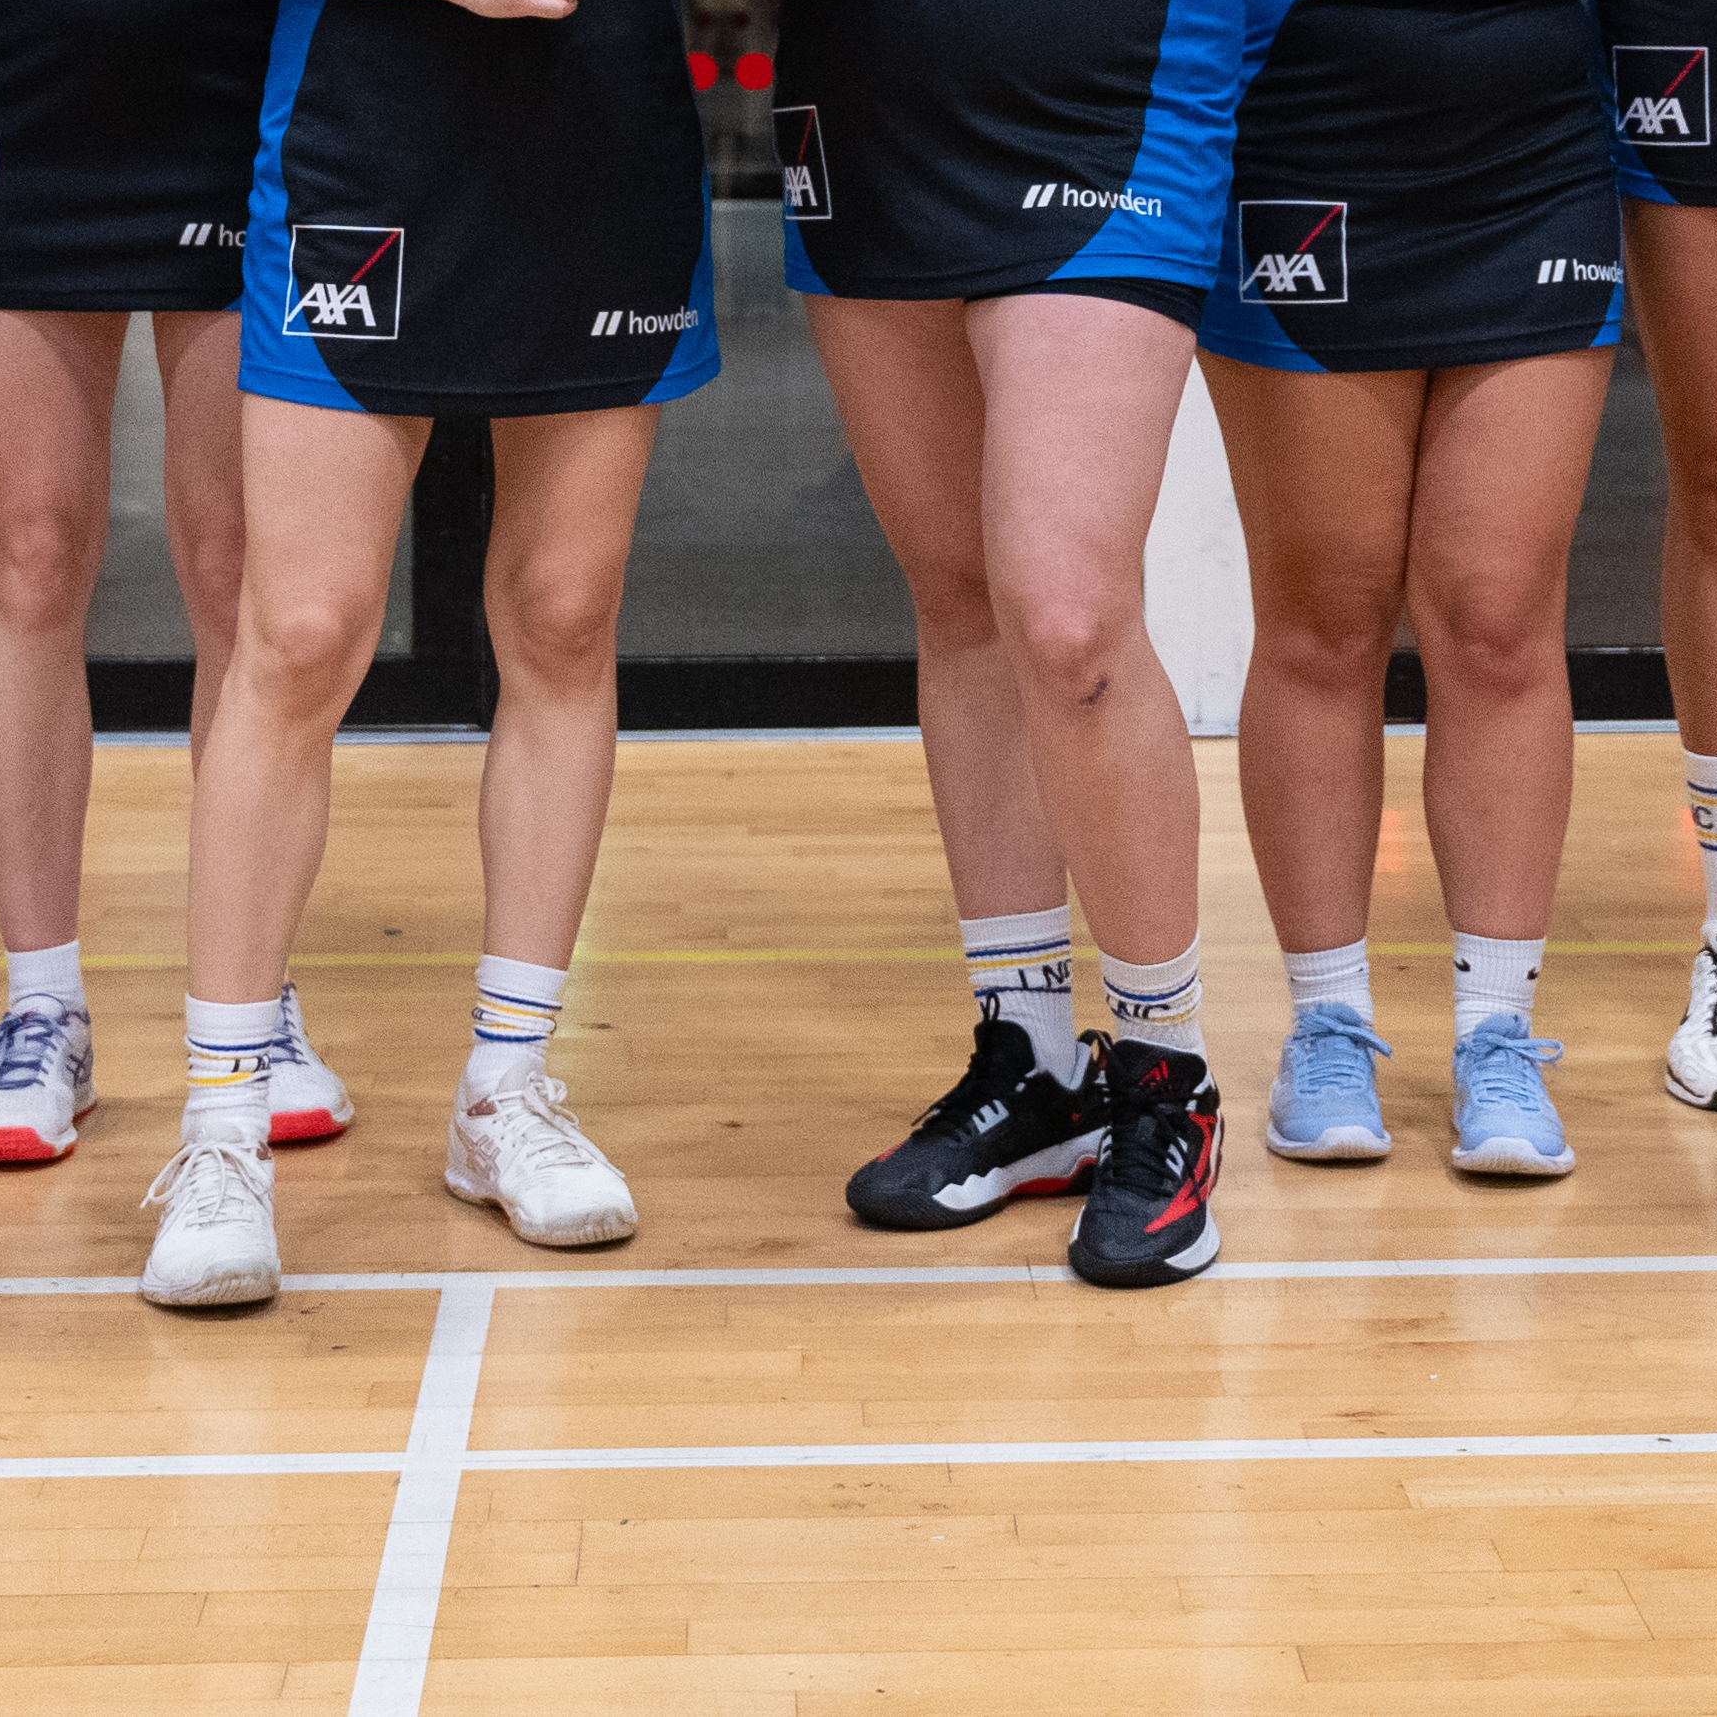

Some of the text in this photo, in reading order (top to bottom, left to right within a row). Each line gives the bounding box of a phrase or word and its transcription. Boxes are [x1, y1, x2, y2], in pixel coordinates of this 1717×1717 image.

[1617, 97, 1690, 135] AXA
[1061, 173, 1163, 217] howden
[1241, 253, 1327, 293] AXA
[286, 283, 376, 327] AXA
[628, 305, 700, 335] howden
